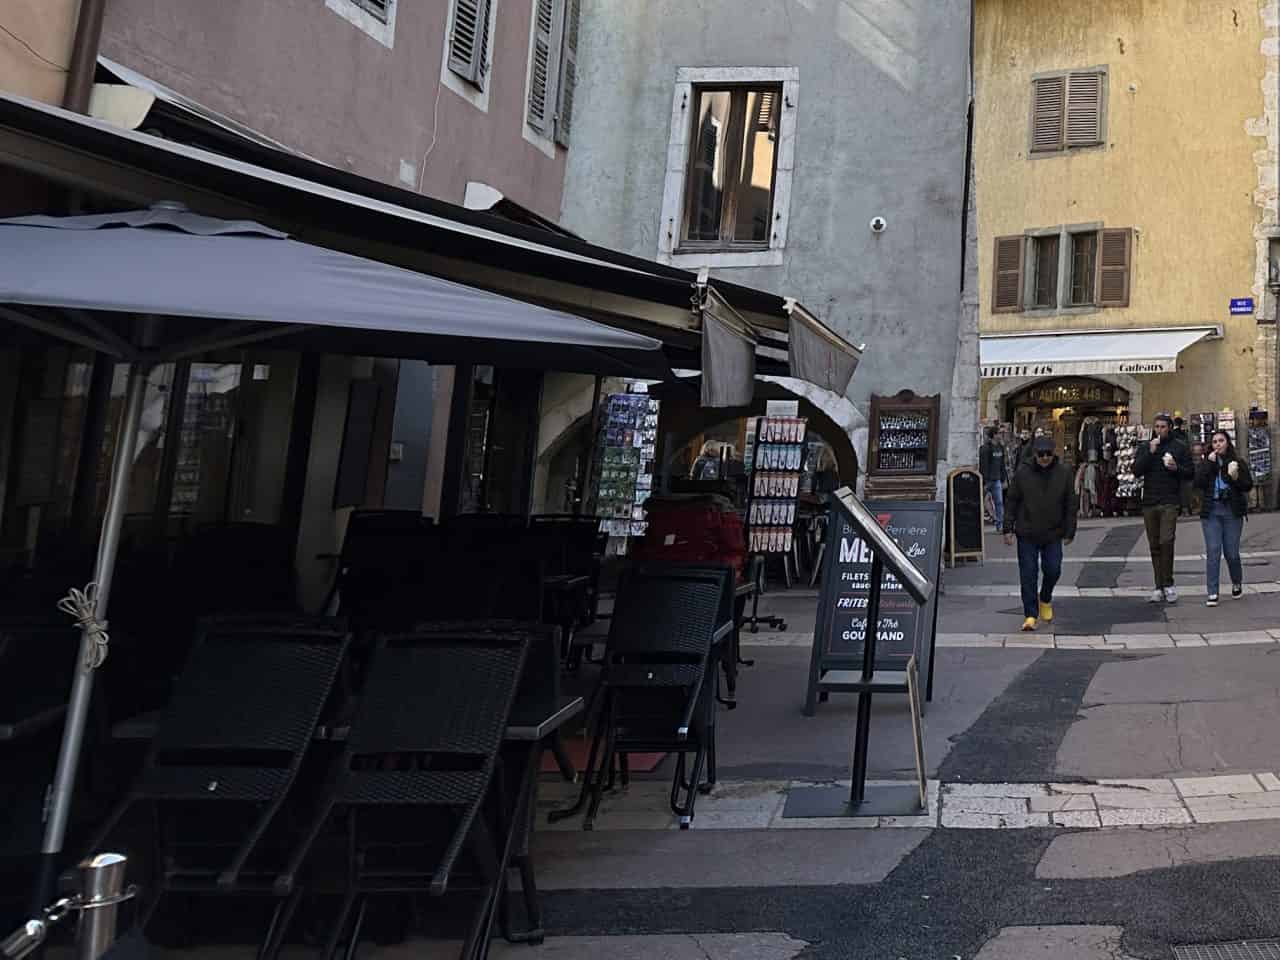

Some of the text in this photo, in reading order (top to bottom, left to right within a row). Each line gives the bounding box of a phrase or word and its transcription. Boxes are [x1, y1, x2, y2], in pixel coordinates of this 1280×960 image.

[841, 572, 869, 581] FILETS
[851, 582, 871, 590] sauc
[837, 597, 869, 608] FRITES
[851, 618, 868, 630] Caf
[842, 630, 904, 641] GOUAND
